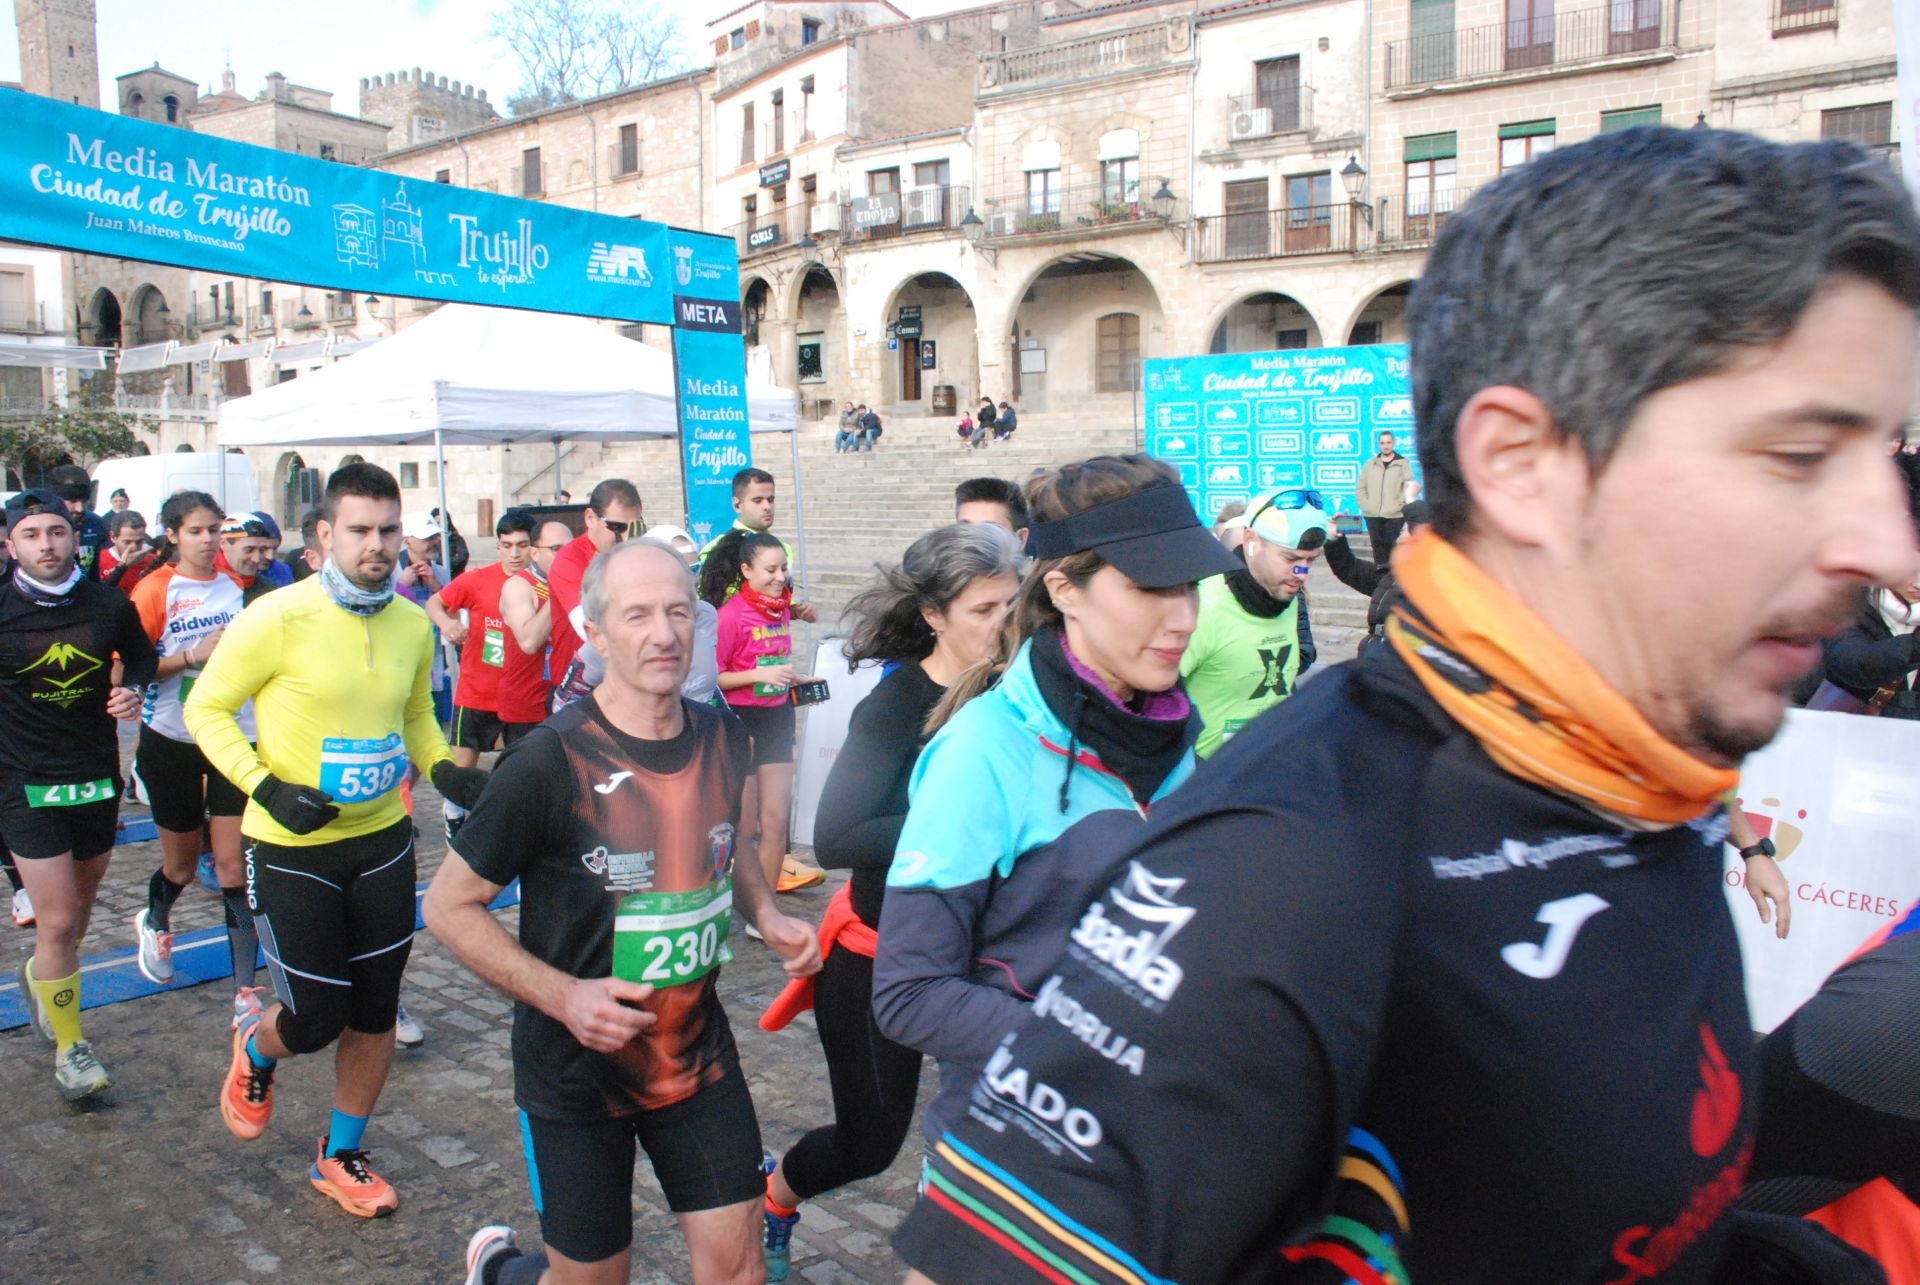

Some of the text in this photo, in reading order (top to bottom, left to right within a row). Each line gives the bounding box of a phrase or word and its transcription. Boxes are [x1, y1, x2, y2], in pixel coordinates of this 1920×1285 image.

[66, 132, 312, 207] Media Maratón
[30, 163, 292, 241] Ciudad de Trujillo
[86, 211, 245, 252] Juan Mateos Broncano
[448, 212, 549, 279] Trujillo
[682, 302, 728, 325] META
[1251, 354, 1347, 370] Media Maratón
[687, 378, 738, 397] Media
[1203, 367, 1375, 393] Ciudad de Trujillo
[686, 404, 744, 421] Maratón
[694, 427, 737, 441] Ciudad de
[688, 443, 747, 475] Trujillo
[339, 762, 396, 797] 538
[244, 848, 258, 911] WONG
[1797, 882, 1898, 917] CÁCERES
[641, 922, 718, 981] 230
